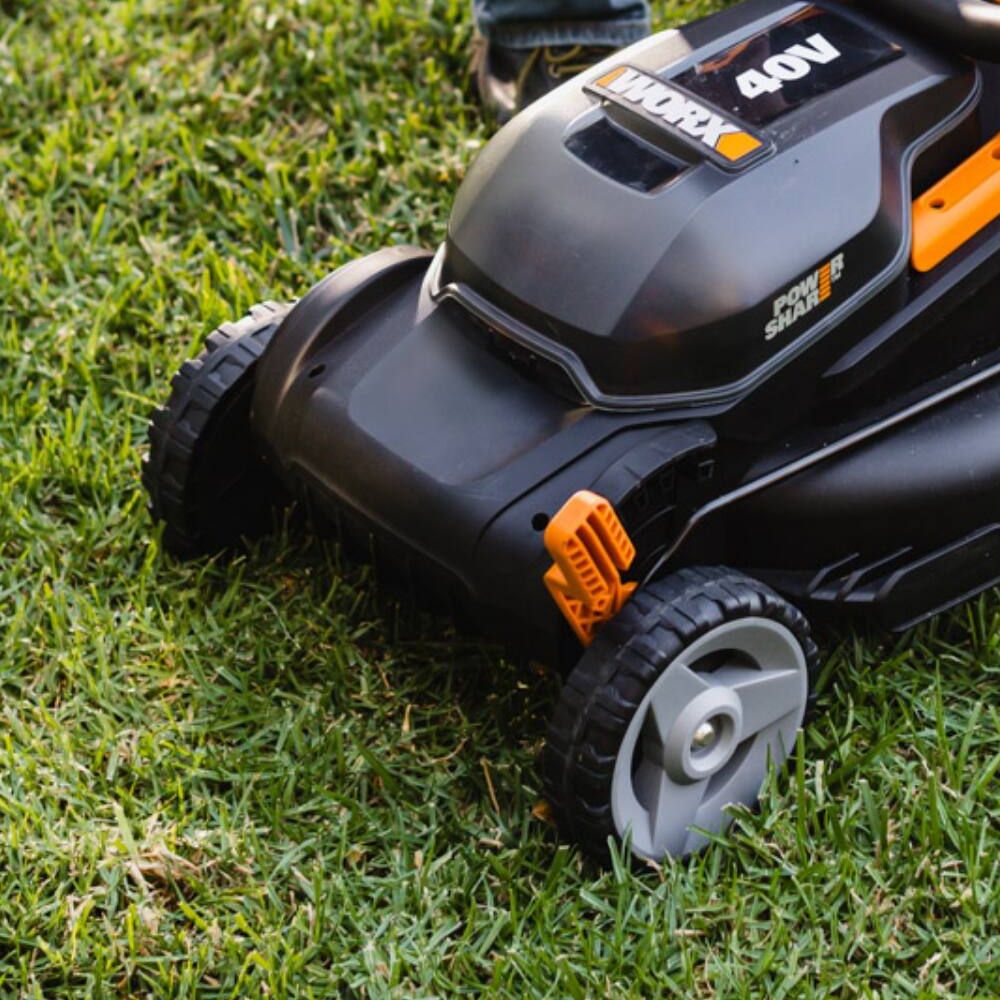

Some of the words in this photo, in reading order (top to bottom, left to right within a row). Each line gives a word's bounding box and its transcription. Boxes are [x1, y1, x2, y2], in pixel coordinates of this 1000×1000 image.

[735, 33, 841, 99] 40V
[606, 68, 742, 149] WORX
[764, 282, 831, 341] SHARE
[772, 252, 845, 317] POWER
